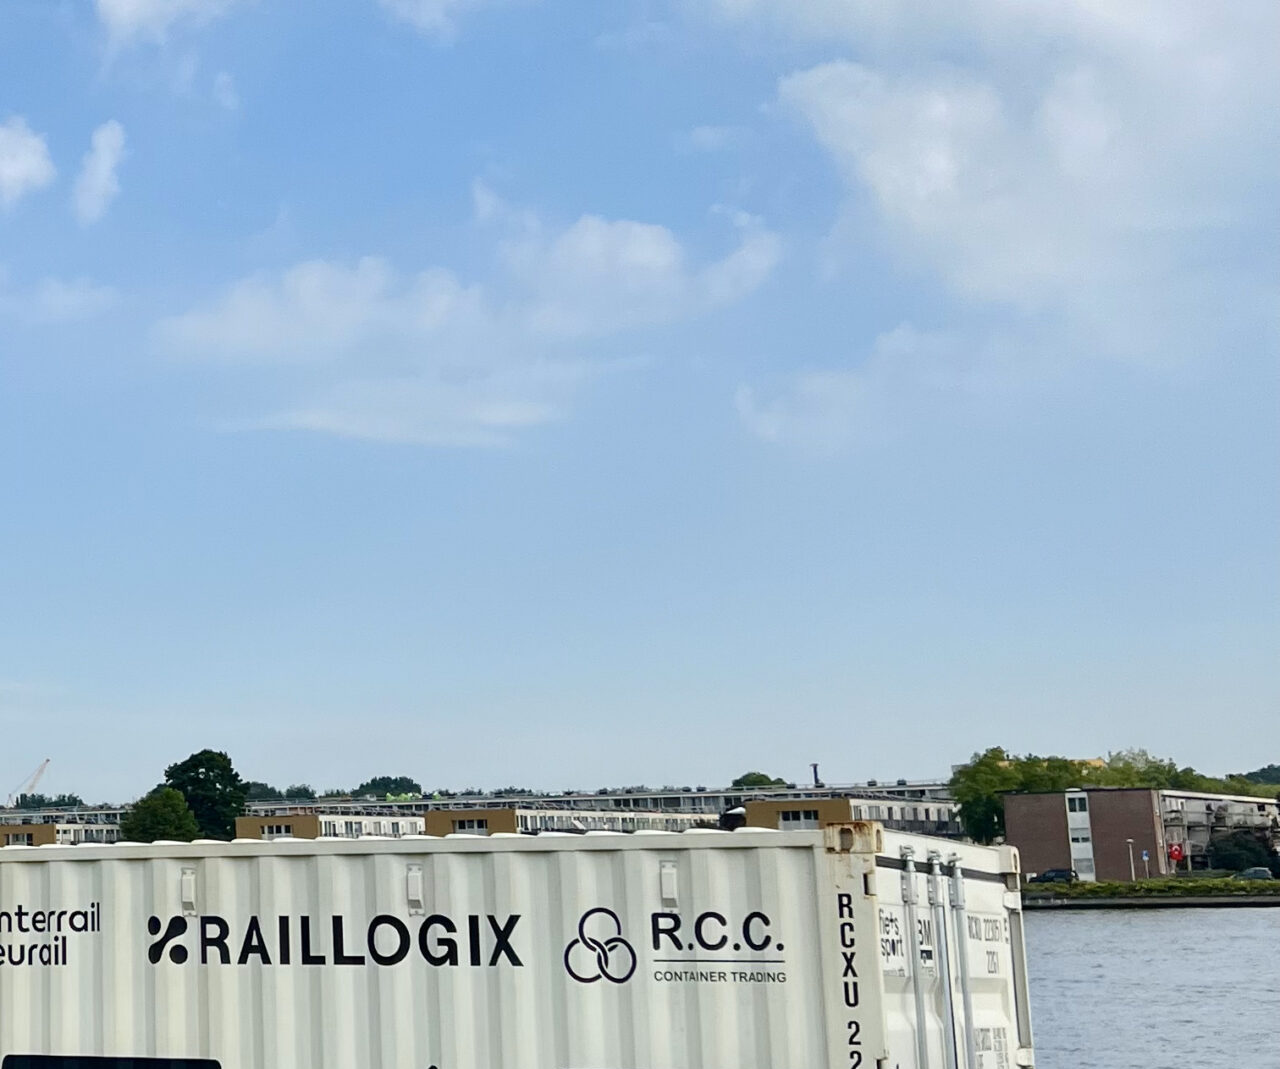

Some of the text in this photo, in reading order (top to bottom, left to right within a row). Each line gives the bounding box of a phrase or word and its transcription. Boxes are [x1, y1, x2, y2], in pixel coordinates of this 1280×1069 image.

[199, 914, 524, 967] RAILLOGIX
[651, 911, 785, 952] R.C.C.
[837, 893, 861, 1008] RCXU
[653, 970, 788, 983] CONTAINER TRADING
